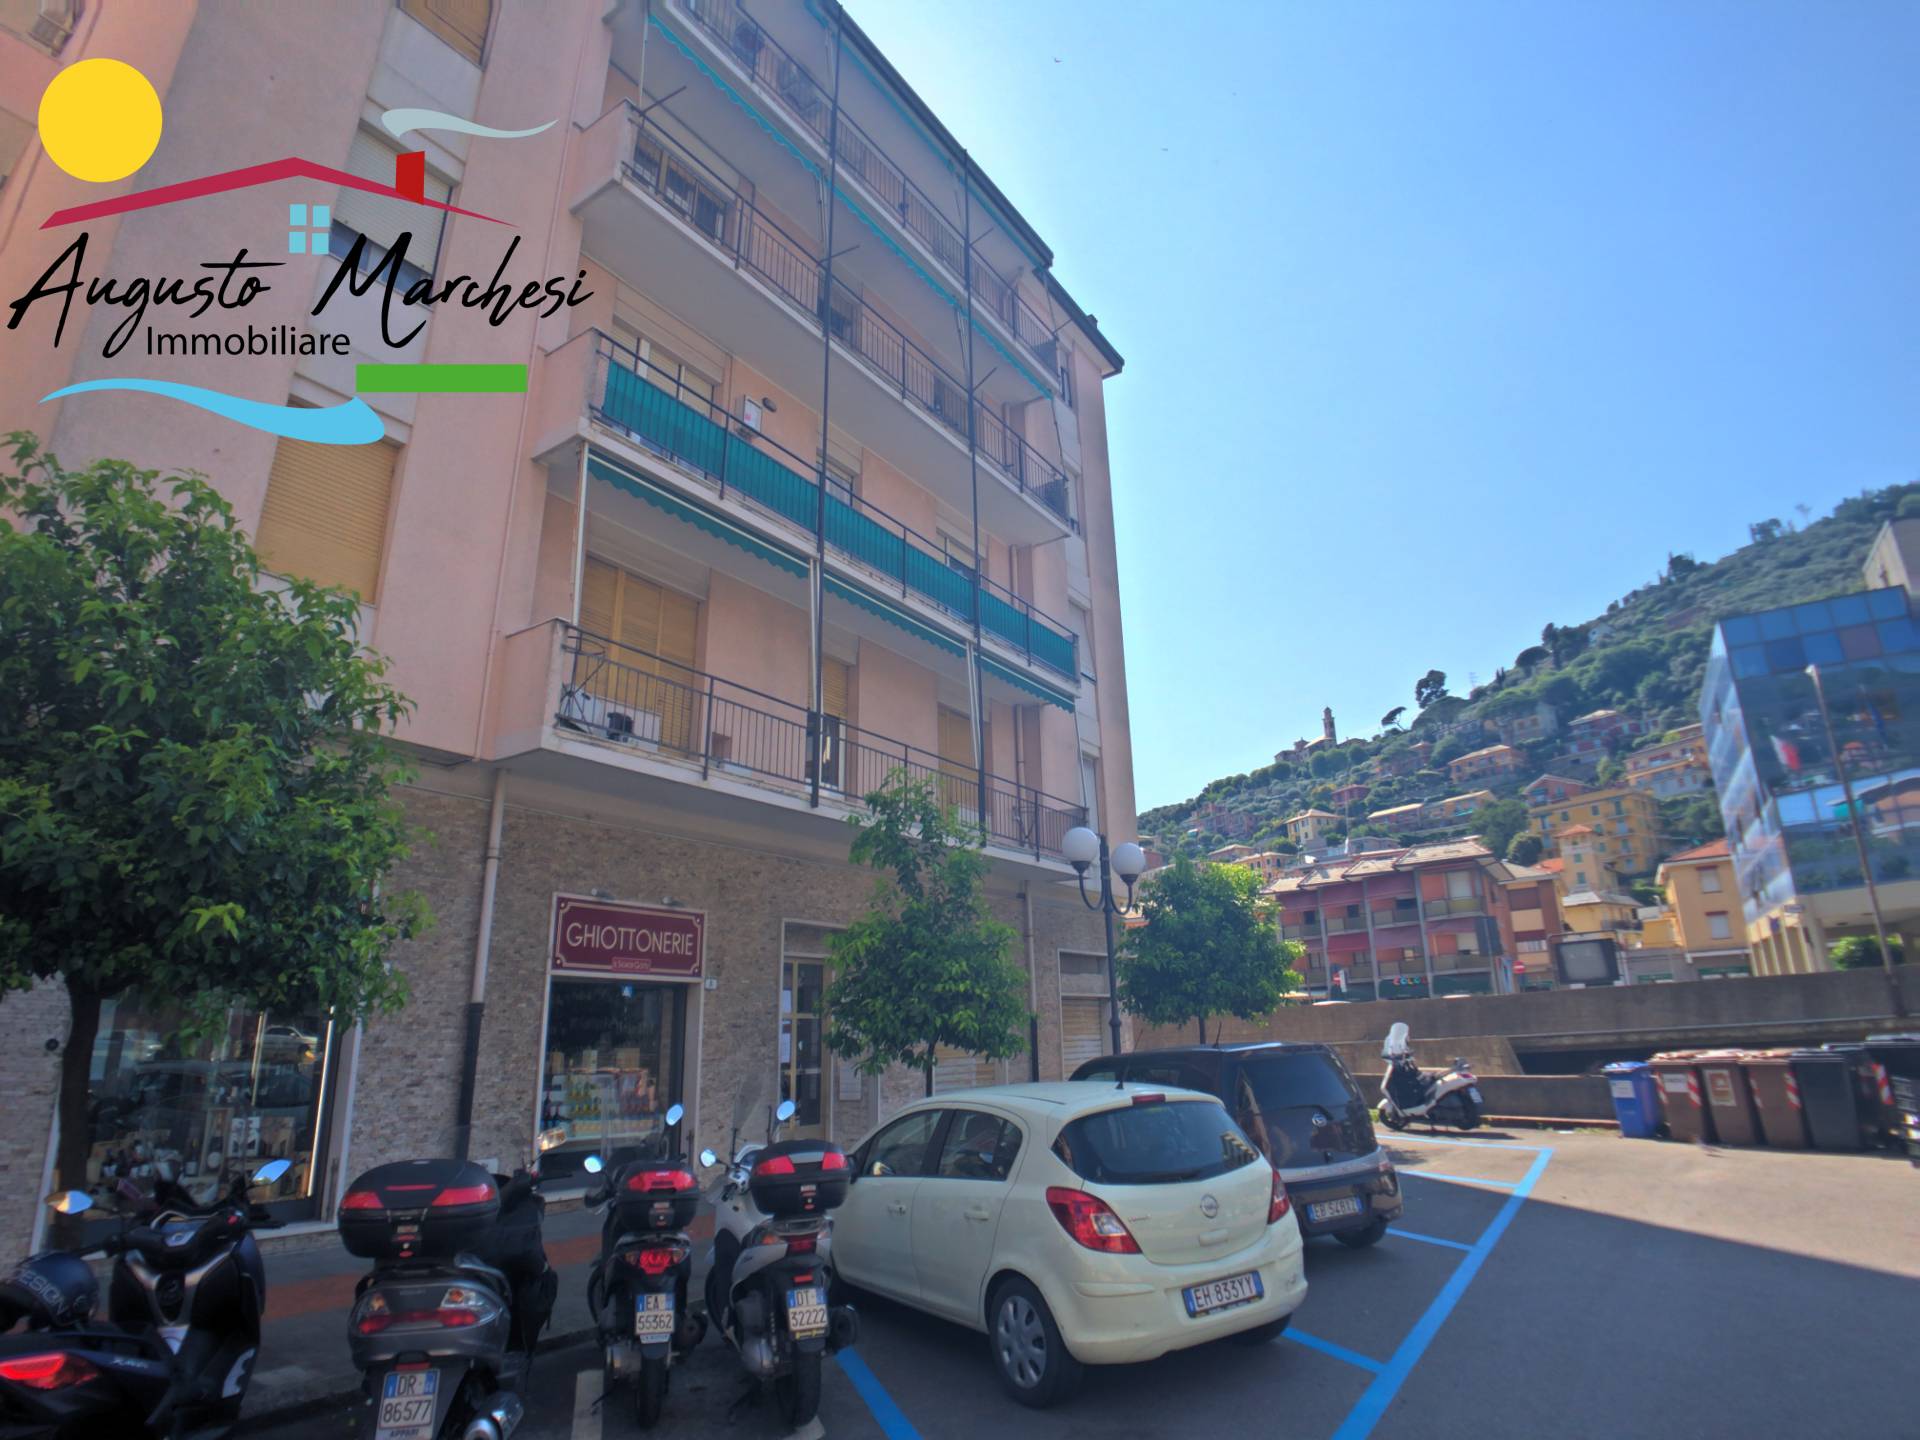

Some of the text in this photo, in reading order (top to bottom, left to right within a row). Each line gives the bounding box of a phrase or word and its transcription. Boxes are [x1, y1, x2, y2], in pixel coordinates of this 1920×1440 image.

[566, 922, 694, 956] GHIOTTONERIE
[1193, 1276, 1255, 1308] EH 833YY
[646, 1295, 660, 1311] EA
[638, 1313, 673, 1331] 55362
[791, 1308, 826, 1327] 32222
[398, 1375, 417, 1396] DR
[383, 1399, 432, 1424] 86577
